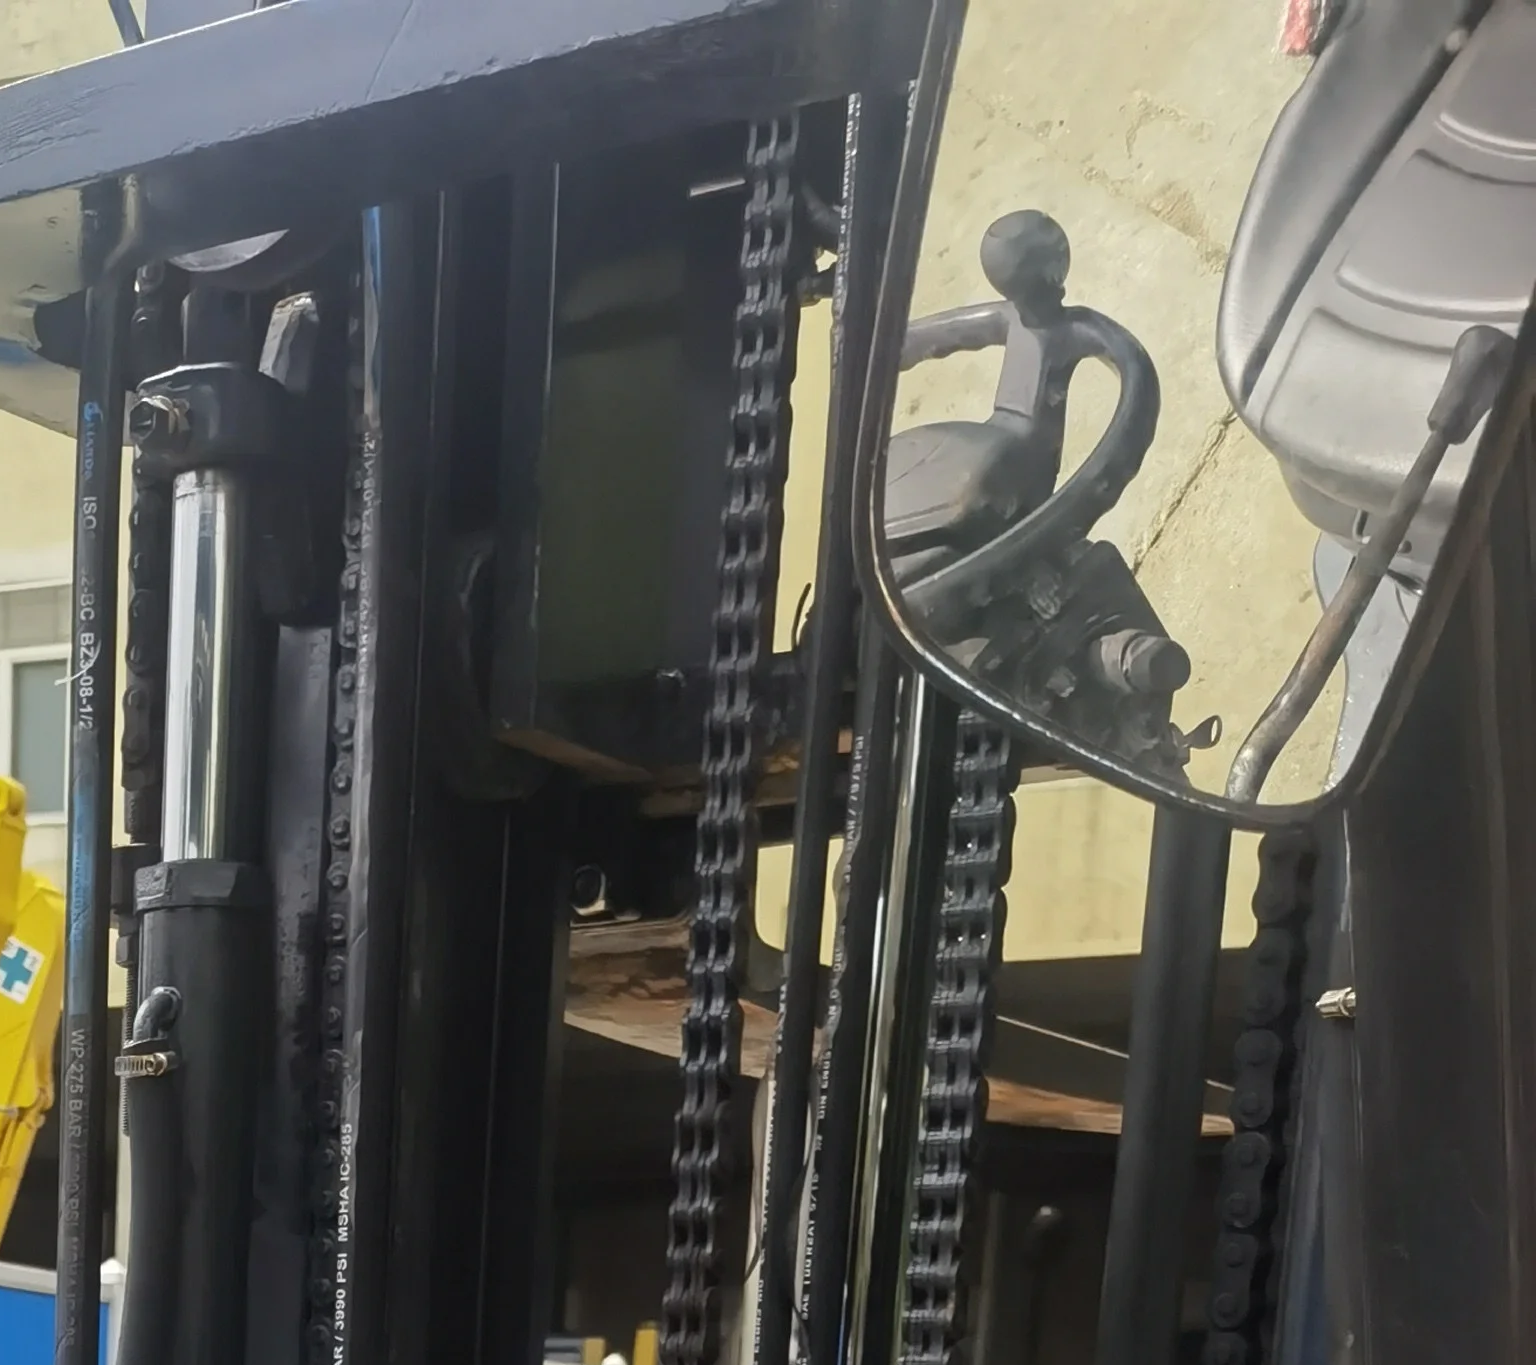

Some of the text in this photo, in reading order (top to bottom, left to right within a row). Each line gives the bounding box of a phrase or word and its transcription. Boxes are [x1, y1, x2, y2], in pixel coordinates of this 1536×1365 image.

[70, 1028, 85, 1060] WP
[69, 1062, 84, 1094] 275
[67, 1098, 83, 1139] BAR
[339, 1124, 353, 1181] IC-285
[337, 1186, 351, 1242] MSHA
[336, 1252, 348, 1283] PSI
[334, 1288, 346, 1331] 3990
